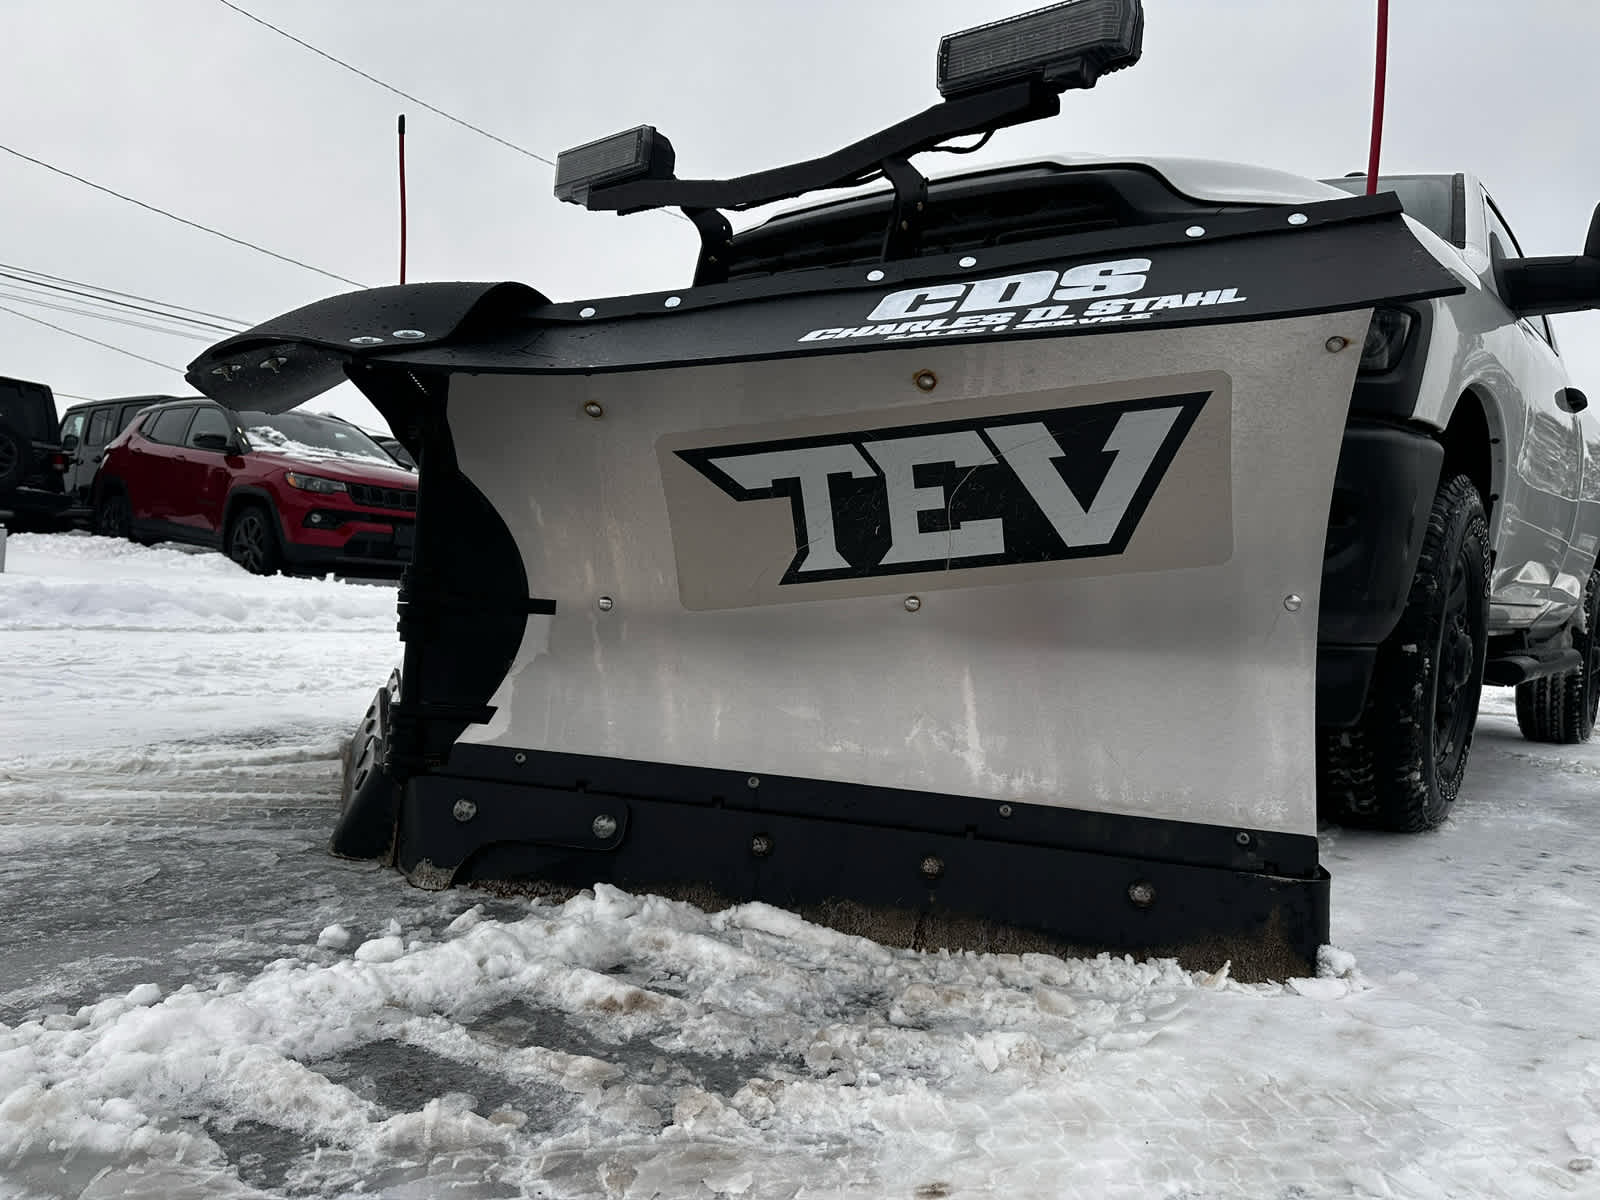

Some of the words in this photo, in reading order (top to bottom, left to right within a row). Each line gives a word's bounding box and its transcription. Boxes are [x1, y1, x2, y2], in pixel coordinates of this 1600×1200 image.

[798, 312, 1017, 342] CHARLES
[1021, 305, 1075, 322] D.
[1083, 288, 1248, 317] STAHL
[866, 258, 1152, 321] CDS
[703, 403, 1186, 574] TEV
